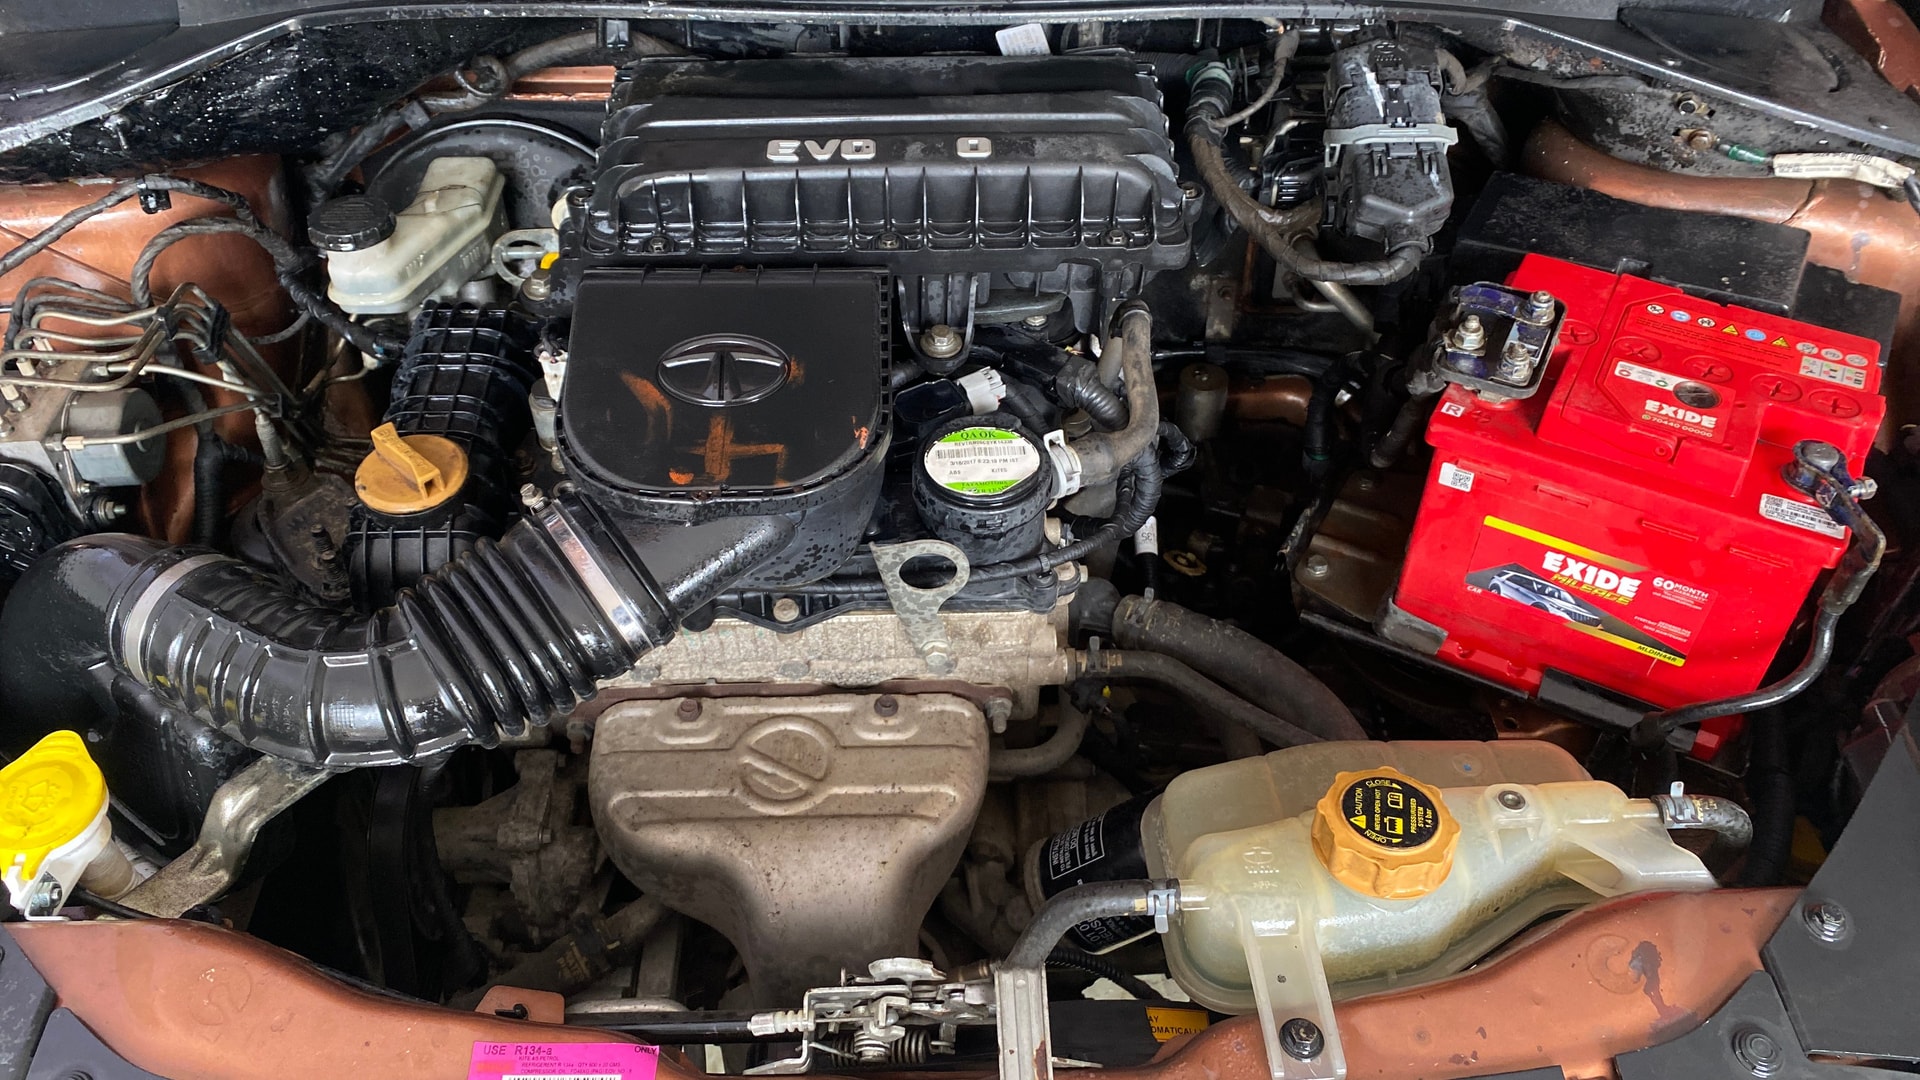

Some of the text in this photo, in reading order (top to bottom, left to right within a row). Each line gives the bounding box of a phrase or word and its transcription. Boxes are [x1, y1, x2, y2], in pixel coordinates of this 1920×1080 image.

[766, 138, 877, 163] EVO
[1445, 404, 1461, 416] R
[1644, 399, 1717, 428] EXIDE
[961, 430, 997, 440] QA OK
[1651, 416, 1712, 438] 70440 00000
[1542, 551, 1642, 599] EXIDE
[1467, 585, 1483, 595] CAR
[1551, 573, 1635, 606] MILEAGE
[1653, 576, 1675, 591] 60
[1674, 583, 1709, 599] MONTH
[1637, 645, 1678, 662] MLDIN44R
[1355, 787, 1363, 815] CAUTION
[1425, 808, 1433, 819] bar
[1364, 829, 1387, 844] OPEN
[484, 1045, 657, 1056] USE R134-a ONLY
